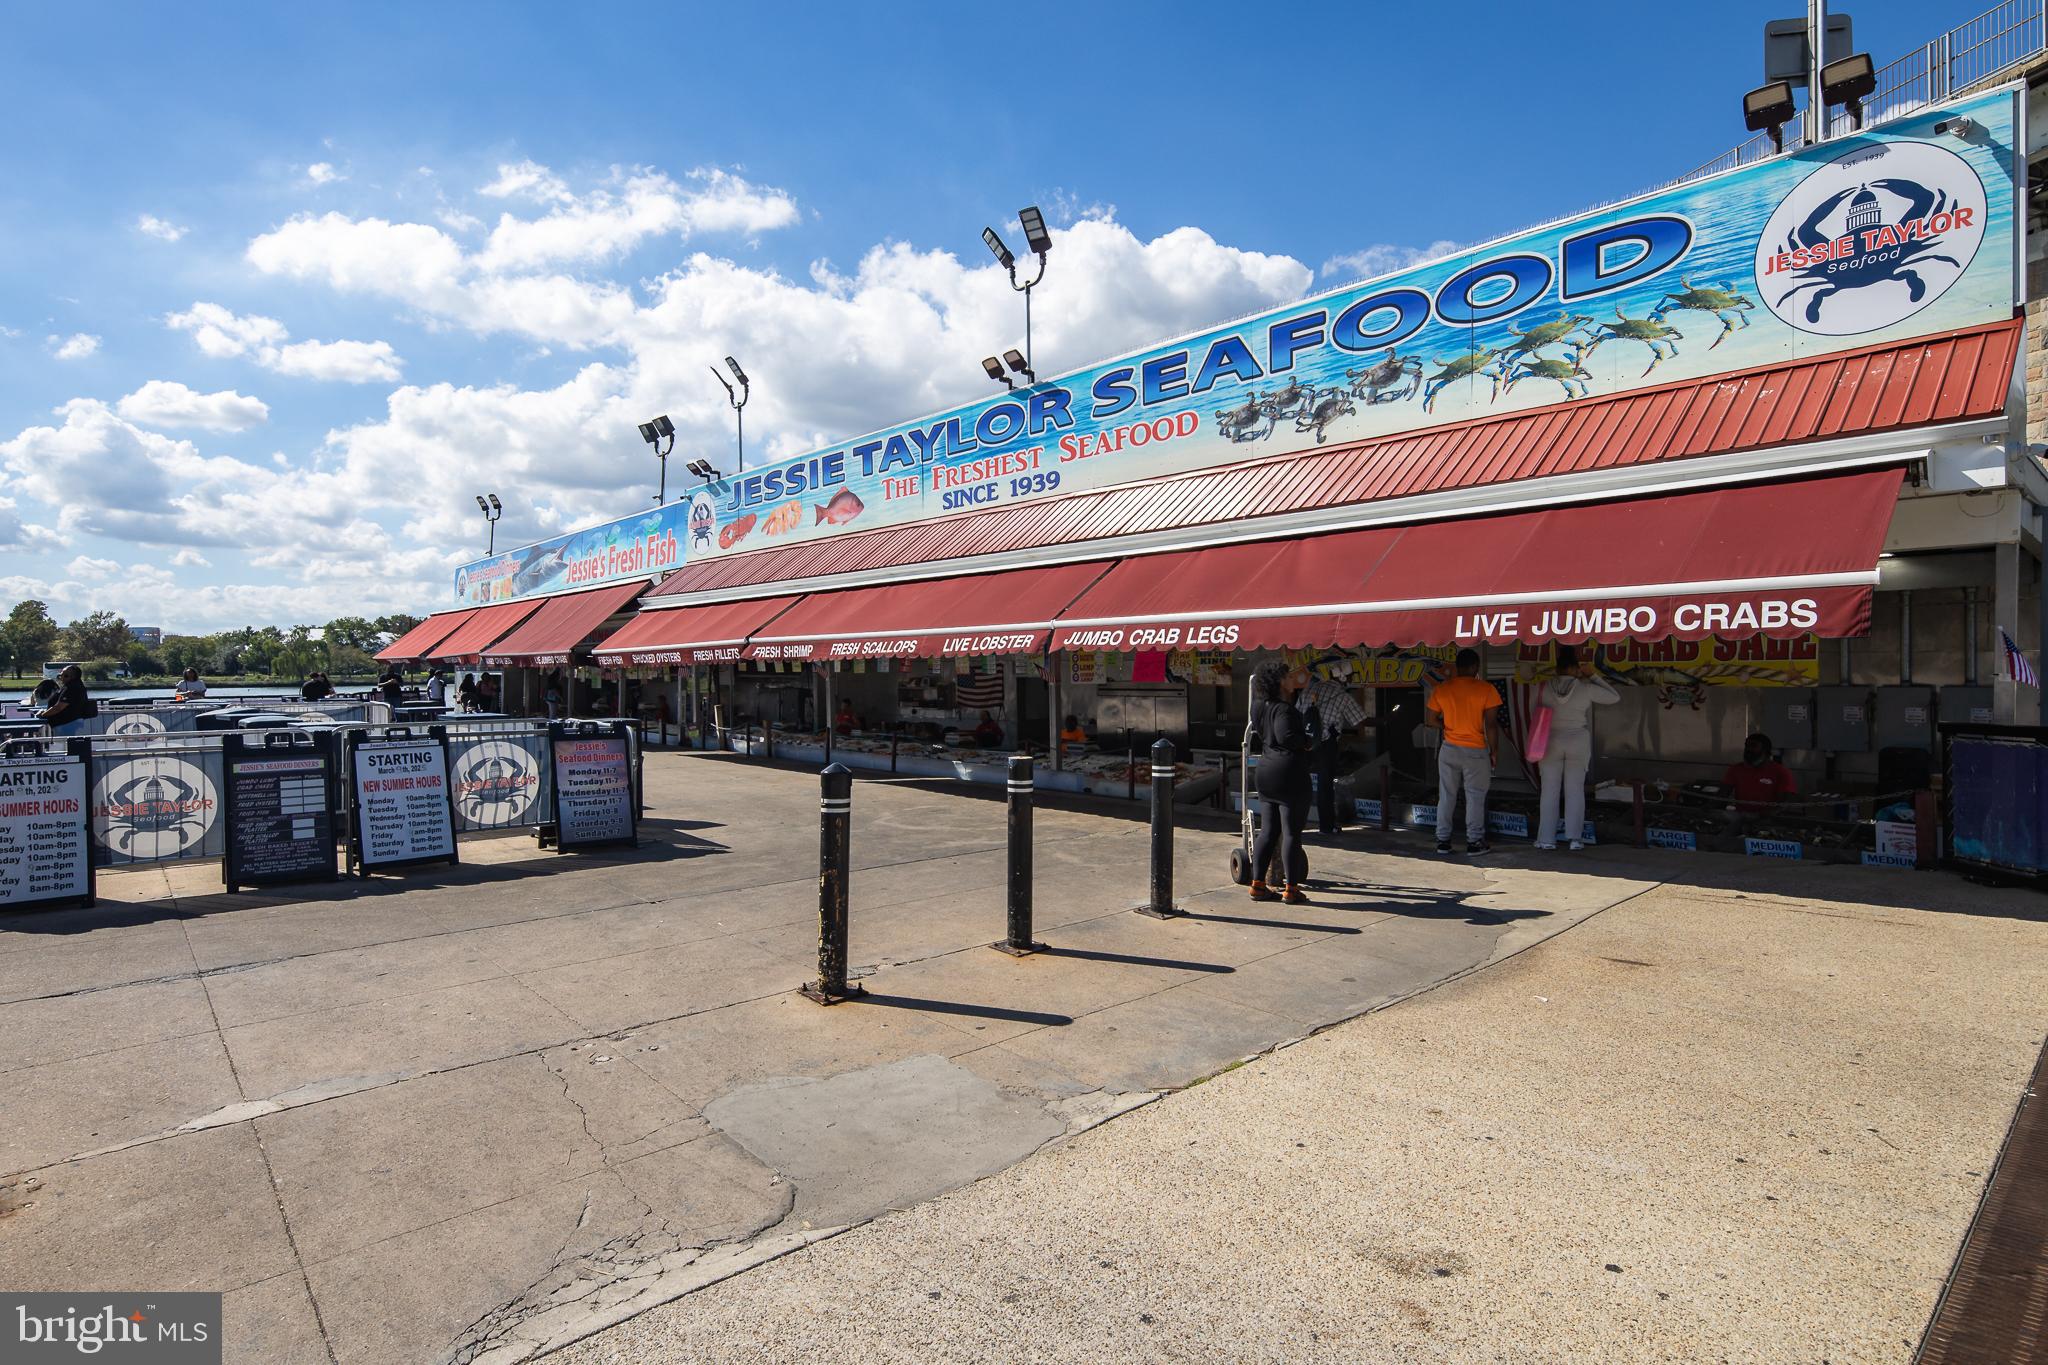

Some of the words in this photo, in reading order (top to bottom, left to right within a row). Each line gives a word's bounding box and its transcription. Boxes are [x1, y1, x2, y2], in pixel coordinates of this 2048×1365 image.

[1865, 152, 1885, 163] 1939
[1764, 236, 1854, 276] JESSIE
[1861, 207, 1974, 251] TAYLOR
[1827, 250, 1900, 274] Seafood
[727, 451, 847, 512] JESSIE
[853, 388, 1074, 477] TAYLOR
[1092, 216, 1694, 418] SEAFOOD
[882, 476, 920, 500] THE
[933, 447, 1044, 491] FRESHEST
[1060, 411, 1199, 463] SEAFOOD
[942, 482, 1000, 510] SINCE
[1010, 470, 1061, 498] 1939
[567, 547, 606, 584] Jessie's
[608, 536, 643, 576] Fresh
[646, 528, 678, 568] Fish
[1455, 613, 1519, 638] LIVE
[1531, 606, 1657, 636] JUMBO
[1673, 599, 1818, 631] CRABS
[1064, 629, 1124, 646] JUMBO
[1129, 627, 1181, 645] CRAB
[1186, 625, 1240, 645] LEGS
[830, 642, 860, 656] FRESH
[861, 640, 918, 654] SCALLOPS
[942, 638, 969, 652] LIVE
[969, 634, 1034, 651] LOBSTER
[693, 649, 714, 661] FRESH
[715, 648, 741, 660] FILLETS
[752, 645, 781, 658] FRESH
[784, 644, 813, 658] SHRIMP
[656, 651, 681, 663] OYSTERS
[575, 742, 608, 751] Jessie's
[368, 752, 433, 766] STARTING
[559, 754, 593, 763] Seafood
[593, 752, 624, 762] Dinners
[363, 780, 380, 792] NEW
[382, 777, 415, 791] SUMMER
[416, 775, 442, 788] HOURS
[562, 788, 611, 797] Wednesday
[368, 797, 395, 805] Monday
[405, 794, 441, 802] 10am-8pm
[568, 799, 607, 807] Thursday
[44, 799, 79, 815] HOURS
[92, 802, 149, 818] JESSIE
[153, 799, 214, 813] TAYLOR
[368, 806, 398, 814] Tuesday
[406, 802, 442, 810] 10am-8pm
[134, 814, 175, 823] Seafood
[369, 813, 405, 822] Wednesday
[407, 811, 443, 819] 10am-8pm
[573, 809, 600, 817] Friday
[27, 821, 76, 830] 10am-8pm
[370, 823, 403, 831] Thursday
[408, 819, 443, 827] 10am-8pm
[570, 819, 609, 827] Saturday
[27, 831, 77, 840] 10am-8pm
[371, 832, 394, 840] Friday
[1651, 831, 1690, 842] LARGE
[28, 841, 77, 851] 10am-8pm
[372, 840, 404, 848] Saturday
[1751, 841, 1796, 852] MEDIUM
[27, 852, 77, 862] 10am-8pm
[373, 849, 399, 857] Sunday
[29, 872, 74, 882] 8am-8pm
[30, 882, 74, 892] 8am-8pm
